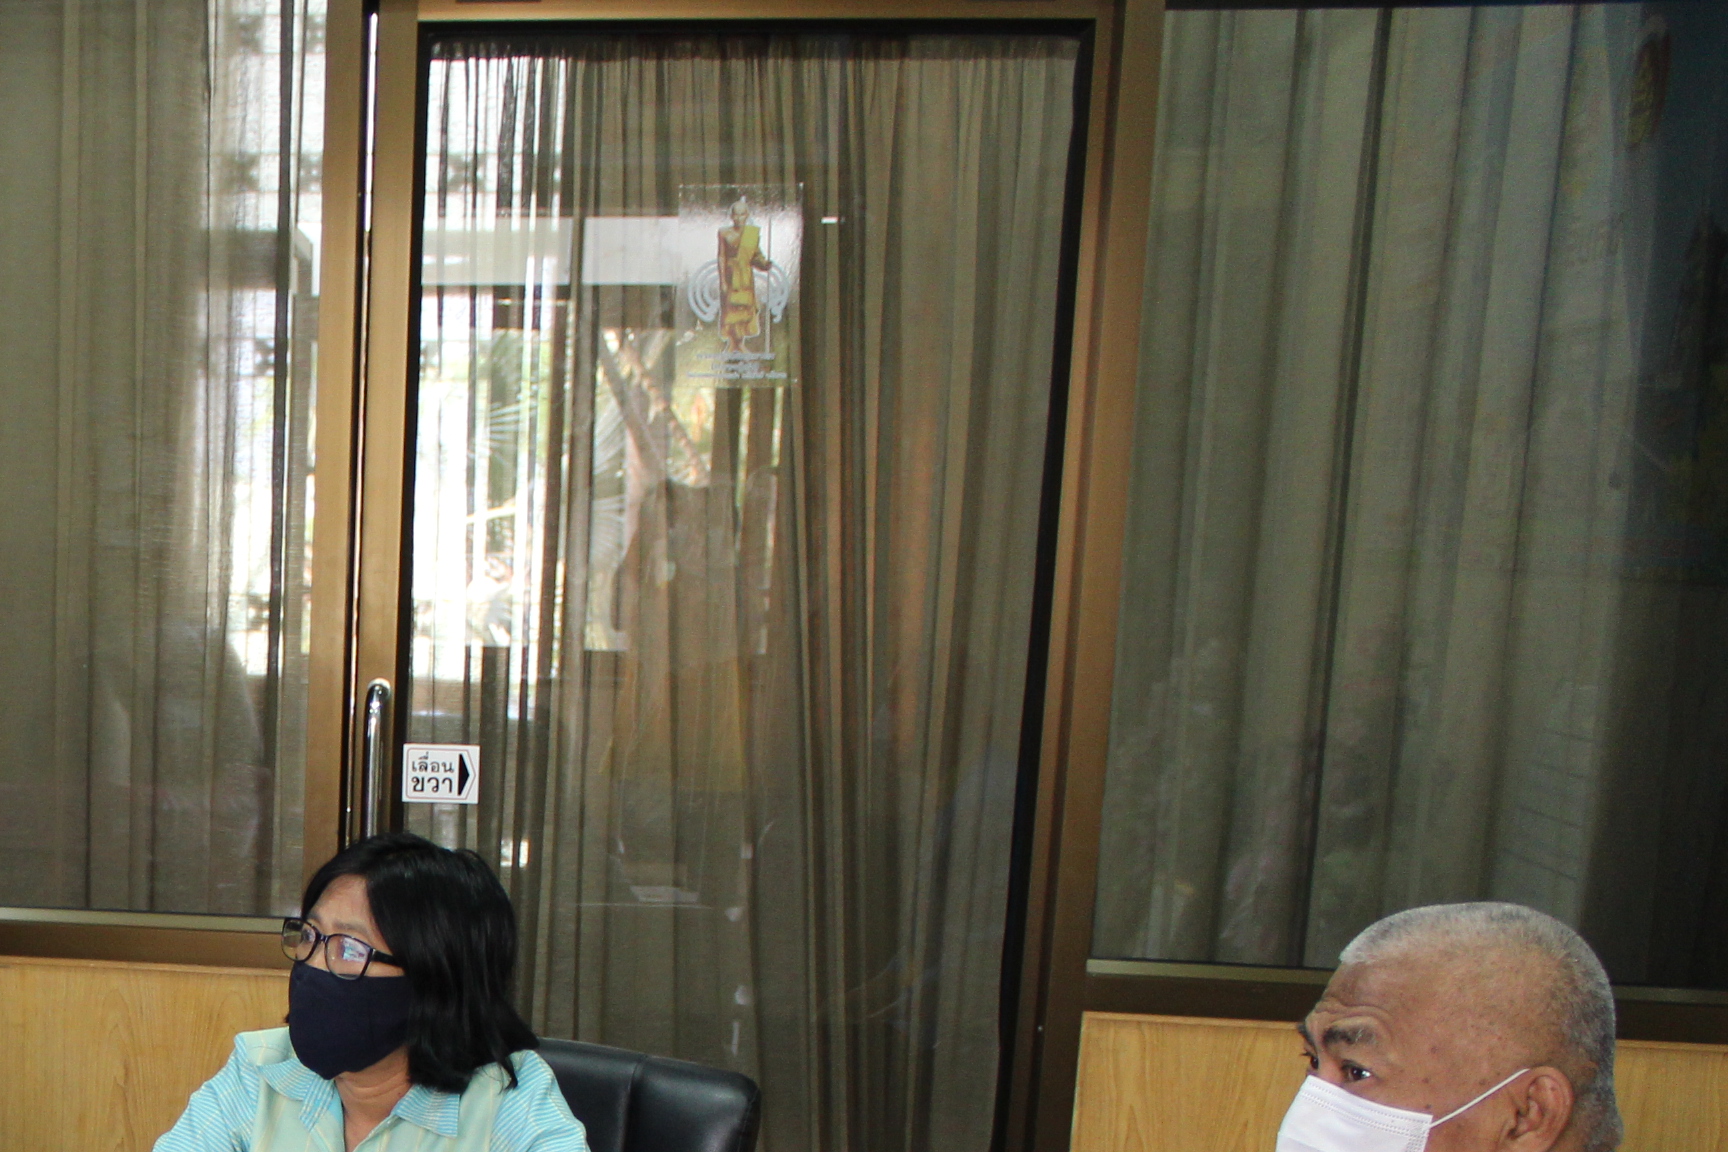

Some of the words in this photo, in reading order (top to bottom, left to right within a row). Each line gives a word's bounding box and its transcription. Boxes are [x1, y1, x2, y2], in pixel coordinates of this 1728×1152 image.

[411, 752, 454, 774] เลื่อน
[411, 776, 454, 793] ขวา
